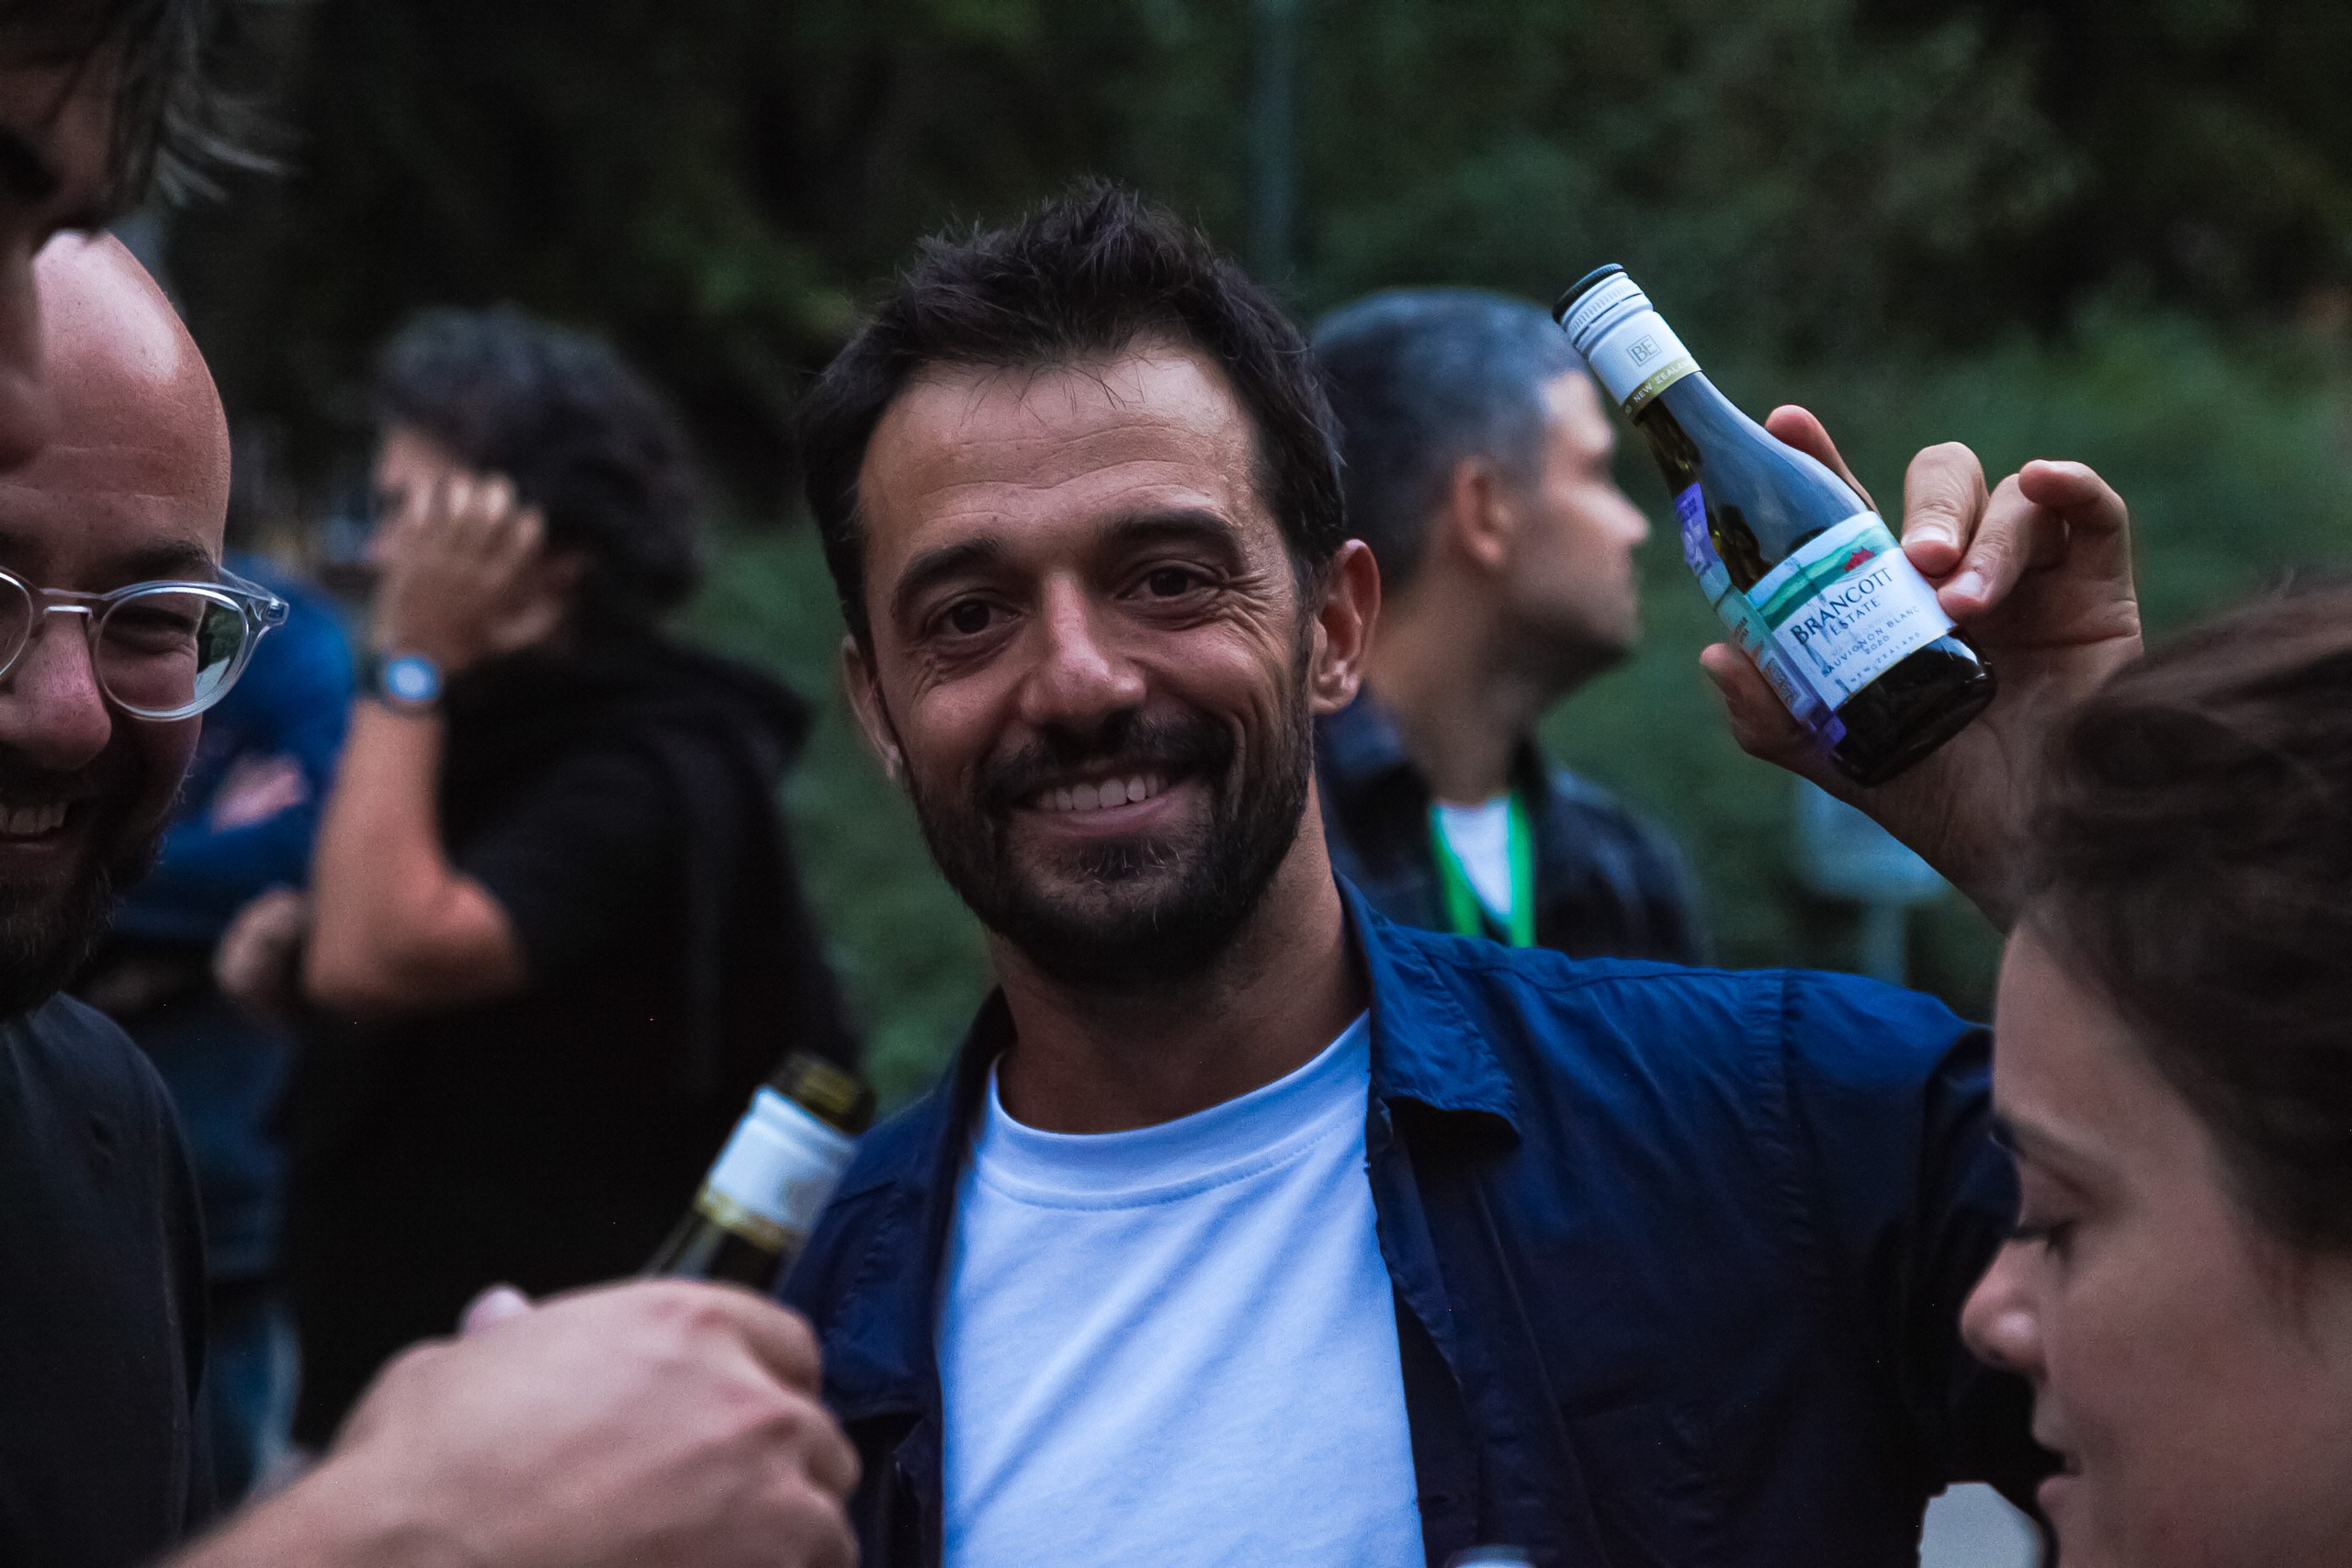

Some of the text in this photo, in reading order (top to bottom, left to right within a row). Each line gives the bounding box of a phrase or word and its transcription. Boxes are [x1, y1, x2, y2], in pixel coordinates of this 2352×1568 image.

[1632, 338, 1657, 362] BE
[1633, 382, 1653, 403] NEW
[1790, 568, 1893, 645] BRANCOTT
[1829, 599, 1881, 636] ESTATE
[1886, 605, 1920, 628] BLANC
